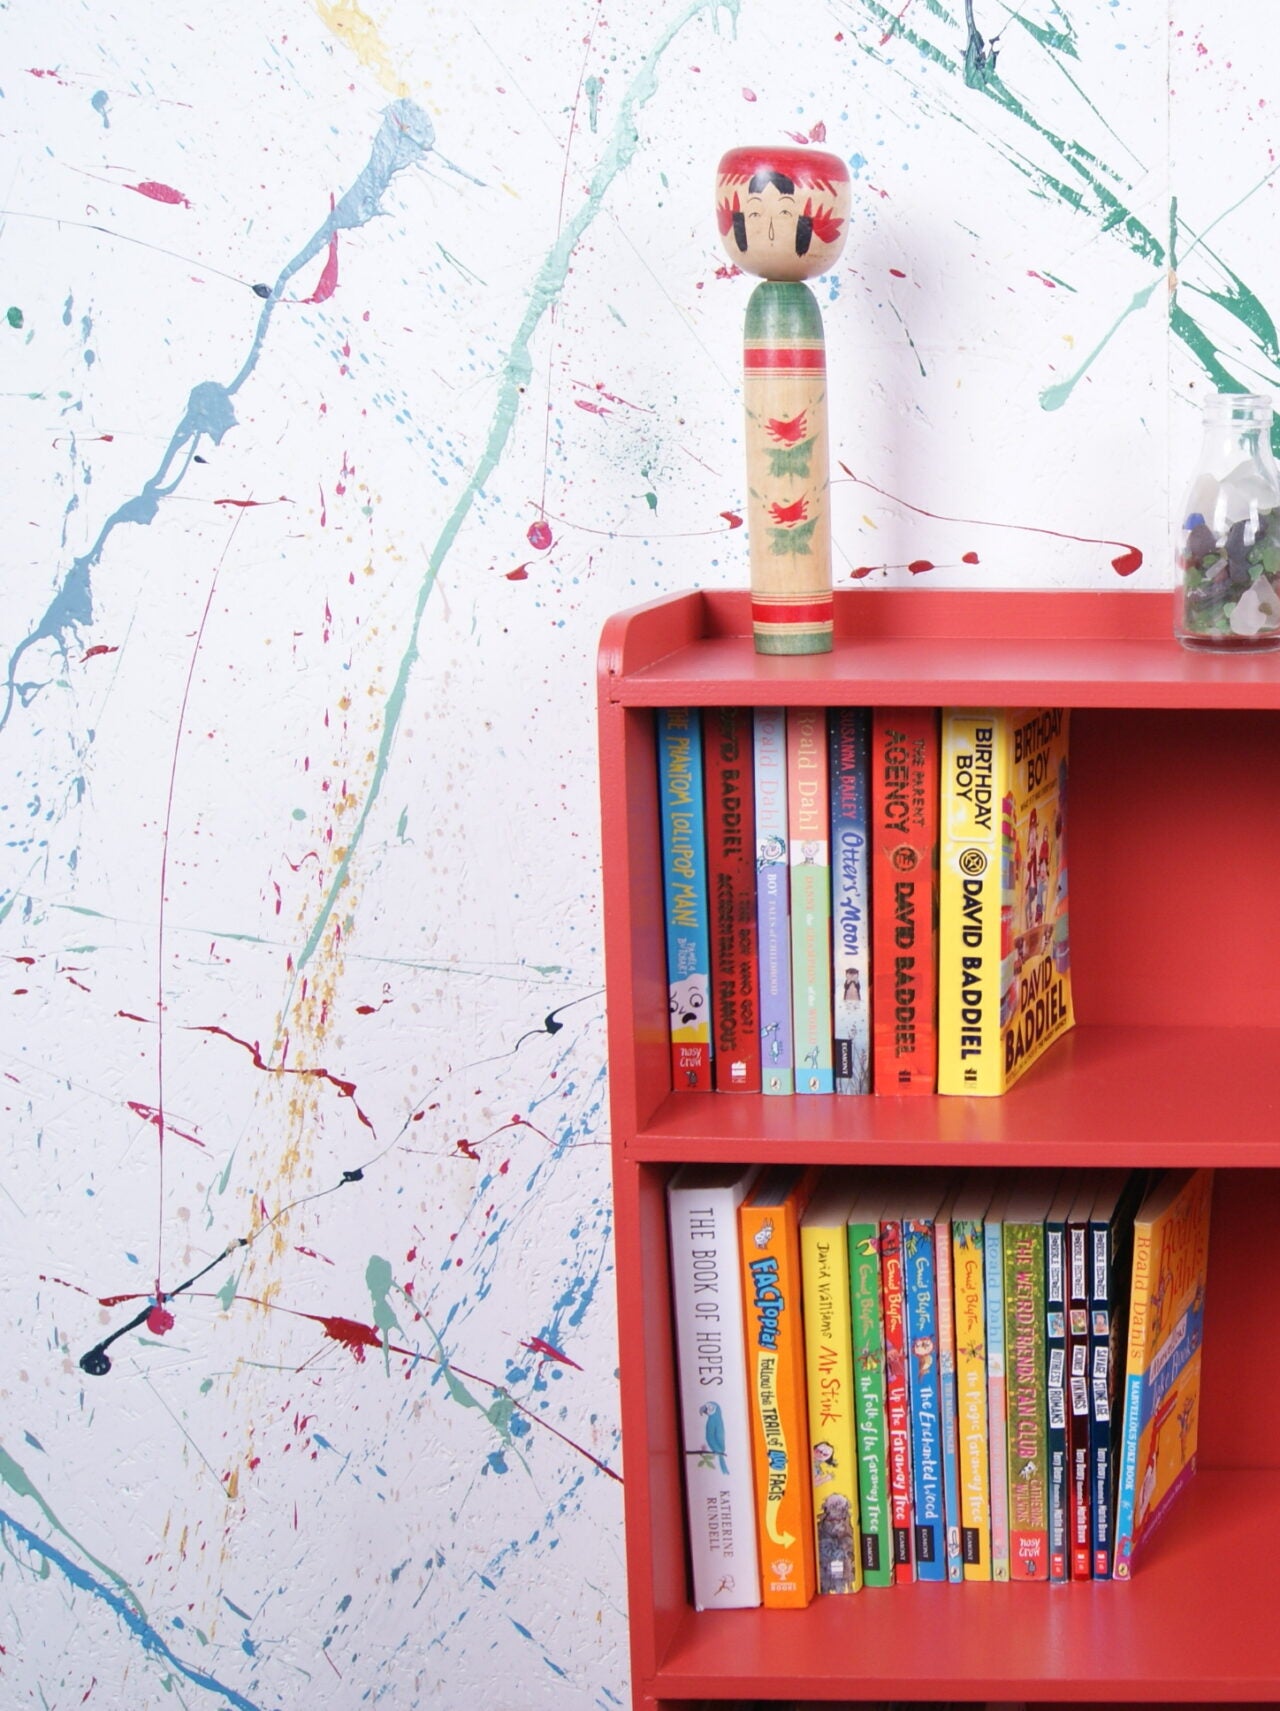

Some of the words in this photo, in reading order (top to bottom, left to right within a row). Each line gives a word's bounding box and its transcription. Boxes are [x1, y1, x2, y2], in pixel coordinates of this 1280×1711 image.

[760, 708, 779, 768] Roald
[799, 711, 818, 770] Roald
[840, 711, 855, 771] SUSANNA
[912, 738, 925, 766] THE
[1014, 708, 1064, 764] BIRTHDAY
[667, 736, 694, 806] PHANTOM
[884, 729, 910, 834] AGENCY
[956, 755, 973, 802] BOY
[974, 728, 993, 831] BIRTHDAY
[1027, 749, 1050, 792] BOY
[721, 769, 742, 858] BADDIEL
[760, 780, 779, 830] Dahl
[799, 780, 819, 831] Dahl
[840, 775, 856, 820] BAILEY
[912, 770, 925, 828] PARENT
[671, 813, 696, 878] LOLLIPOP
[840, 832, 864, 898] Otters'
[672, 882, 699, 928] MAN!
[767, 873, 777, 898] BOY
[840, 896, 861, 956] Moon
[894, 882, 915, 949] DAVID
[962, 880, 983, 947] DAVID
[1020, 955, 1053, 1012] DAVID
[719, 980, 737, 1052] FAMOUS
[894, 957, 915, 1058] BADDIEL
[961, 957, 982, 1060] BADDIEL
[1005, 979, 1067, 1074] BADDIEL
[689, 1208, 715, 1240] THE
[692, 1250, 719, 1294] BOOK
[817, 1242, 832, 1280] David
[915, 1257, 929, 1289] Enid
[988, 1236, 1001, 1289] Roald
[1015, 1239, 1034, 1266] THE
[1135, 1236, 1151, 1291] Roald
[859, 1264, 873, 1296] Enid
[886, 1259, 900, 1291] Enid
[965, 1260, 978, 1290] Enid
[695, 1302, 720, 1322] OF
[818, 1282, 834, 1339] Walliams
[860, 1297, 875, 1337] Blyton
[886, 1292, 902, 1332] Blyton
[916, 1291, 931, 1332] Blyton
[965, 1293, 979, 1332] Blyton
[988, 1300, 1002, 1345] Dahl
[696, 1332, 724, 1386] HOPES
[760, 1358, 775, 1389] Follow
[818, 1345, 838, 1375] Mr
[966, 1371, 978, 1389] The
[1095, 1349, 1107, 1374] SAVAGE
[760, 1391, 775, 1406] the
[820, 1378, 842, 1427] Stink
[860, 1376, 873, 1393] The
[890, 1388, 905, 1406] Up
[920, 1385, 933, 1410] The
[1016, 1387, 1037, 1417] FAN
[1072, 1379, 1087, 1410] VIKINGS
[761, 1408, 780, 1437] TRAIL
[863, 1393, 879, 1420] Folk
[966, 1391, 981, 1431] Magic
[1049, 1390, 1064, 1424] ROMANS
[1096, 1403, 1108, 1416] AGE
[1129, 1380, 1140, 1440] MARVELLOUS
[861, 1421, 877, 1436] of
[863, 1437, 879, 1451] the
[919, 1411, 937, 1481] Enchanted
[1016, 1421, 1038, 1459] CLUB
[890, 1430, 908, 1494] Faraway
[966, 1433, 983, 1497] Faraway
[1127, 1439, 1138, 1463] JOKE
[862, 1453, 880, 1506] Faraway
[1125, 1464, 1136, 1490] BOOK
[868, 1505, 881, 1533] Tree
[893, 1493, 910, 1520] Tree
[924, 1483, 938, 1520] Wood
[969, 1495, 984, 1523] Tree
[1029, 1479, 1043, 1528] CATHERINE
[706, 1497, 720, 1552] RUNDELL
[720, 1490, 734, 1558] KATHERINE
